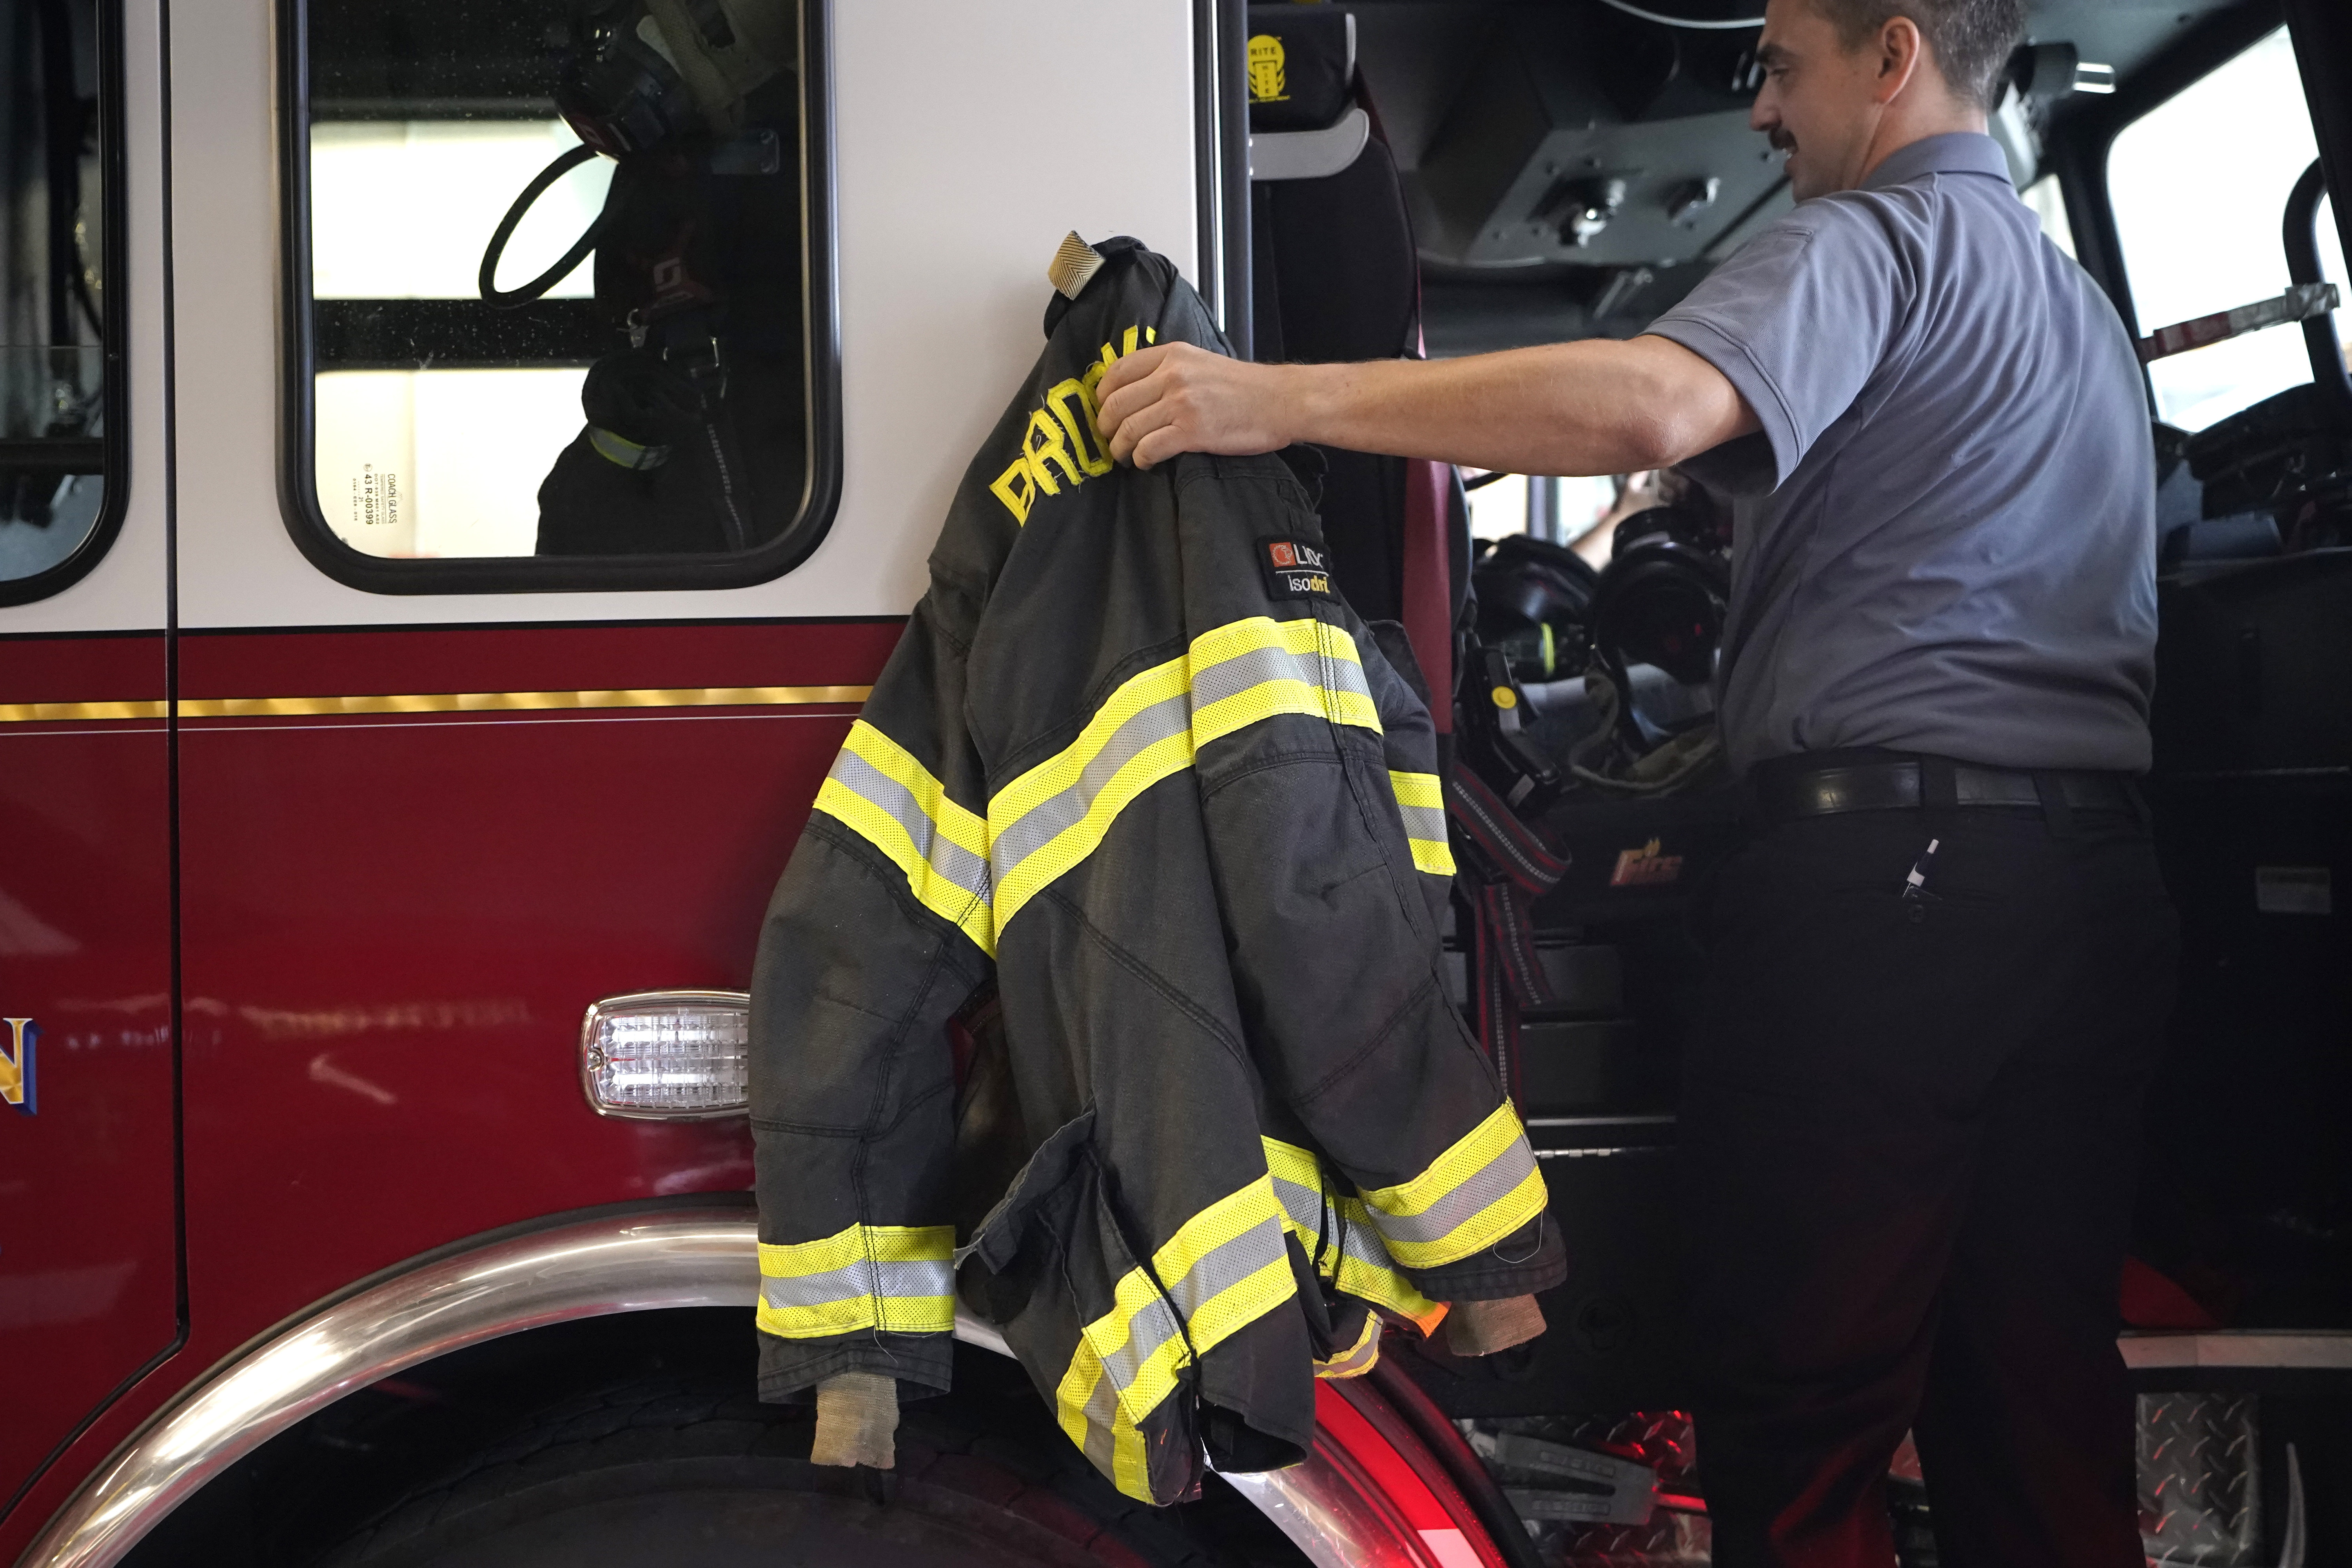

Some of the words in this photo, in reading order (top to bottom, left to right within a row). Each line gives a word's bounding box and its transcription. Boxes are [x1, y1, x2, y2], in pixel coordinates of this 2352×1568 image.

[365, 474, 372, 485] 43
[388, 474, 396, 498] COACH
[365, 488, 374, 524] R-00399
[388, 500, 397, 524] GLASS
